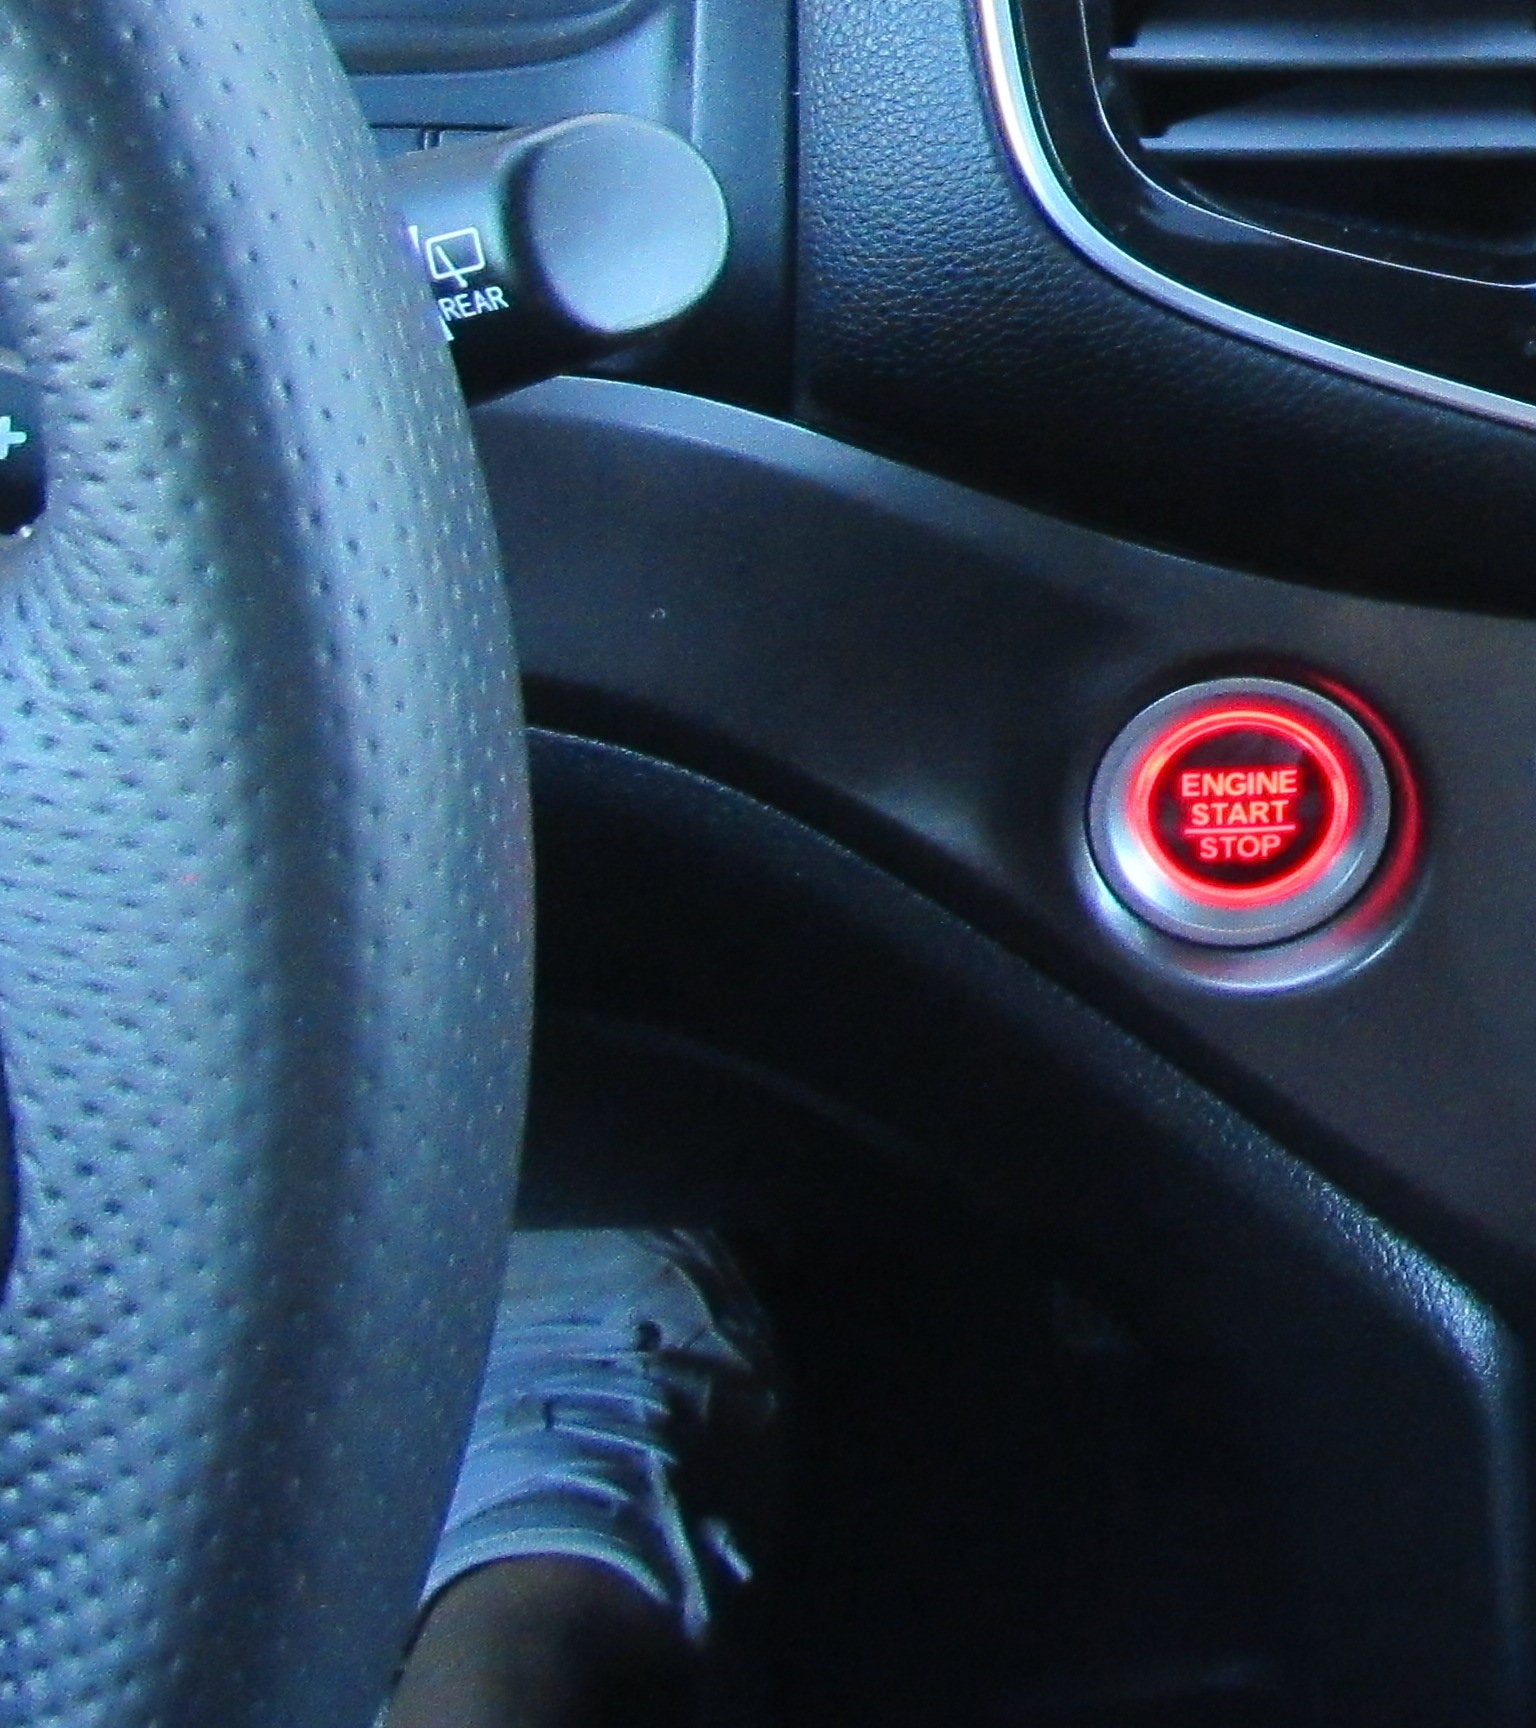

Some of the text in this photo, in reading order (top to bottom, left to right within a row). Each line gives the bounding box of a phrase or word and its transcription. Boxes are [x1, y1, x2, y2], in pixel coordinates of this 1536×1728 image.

[438, 286, 509, 320] REAR
[1182, 770, 1296, 796] ENGINE
[1192, 800, 1289, 826] START
[1200, 834, 1280, 858] STOP
